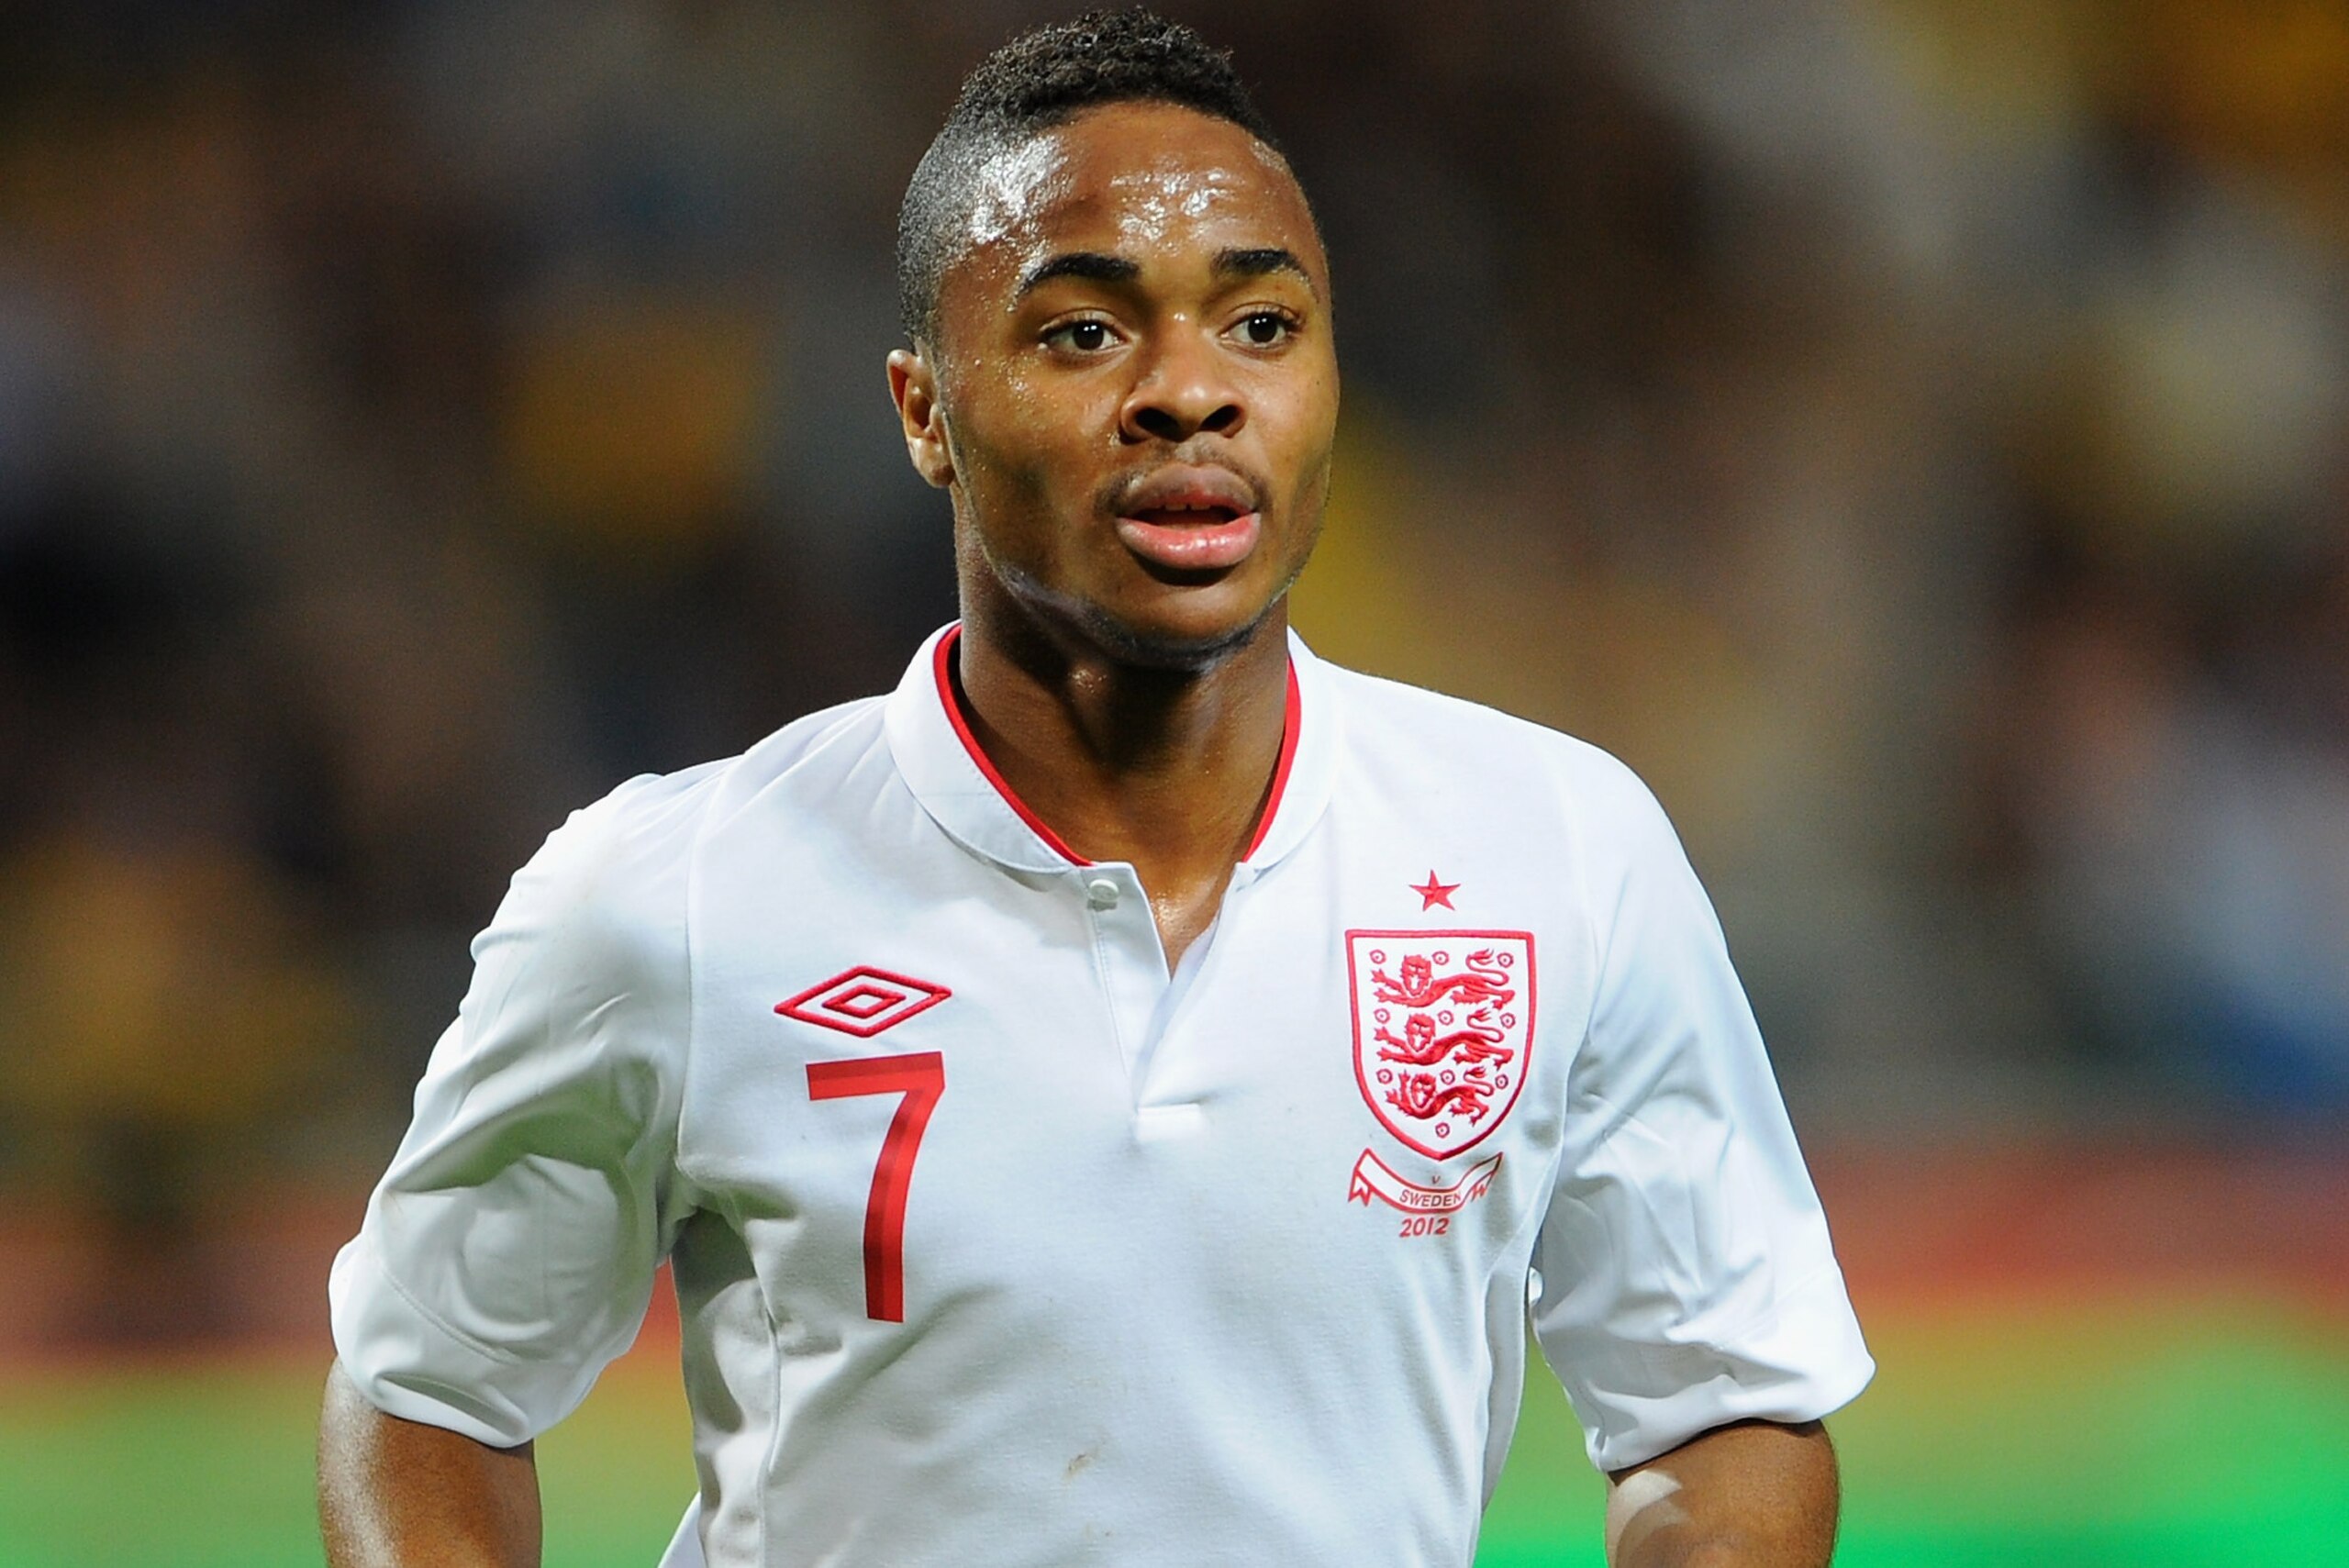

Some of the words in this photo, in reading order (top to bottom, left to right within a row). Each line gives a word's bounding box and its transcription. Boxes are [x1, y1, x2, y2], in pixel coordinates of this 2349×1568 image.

[805, 1051, 946, 1323] 7
[1399, 1189, 1462, 1207] SWEDEN
[1399, 1217, 1450, 1238] 2012
